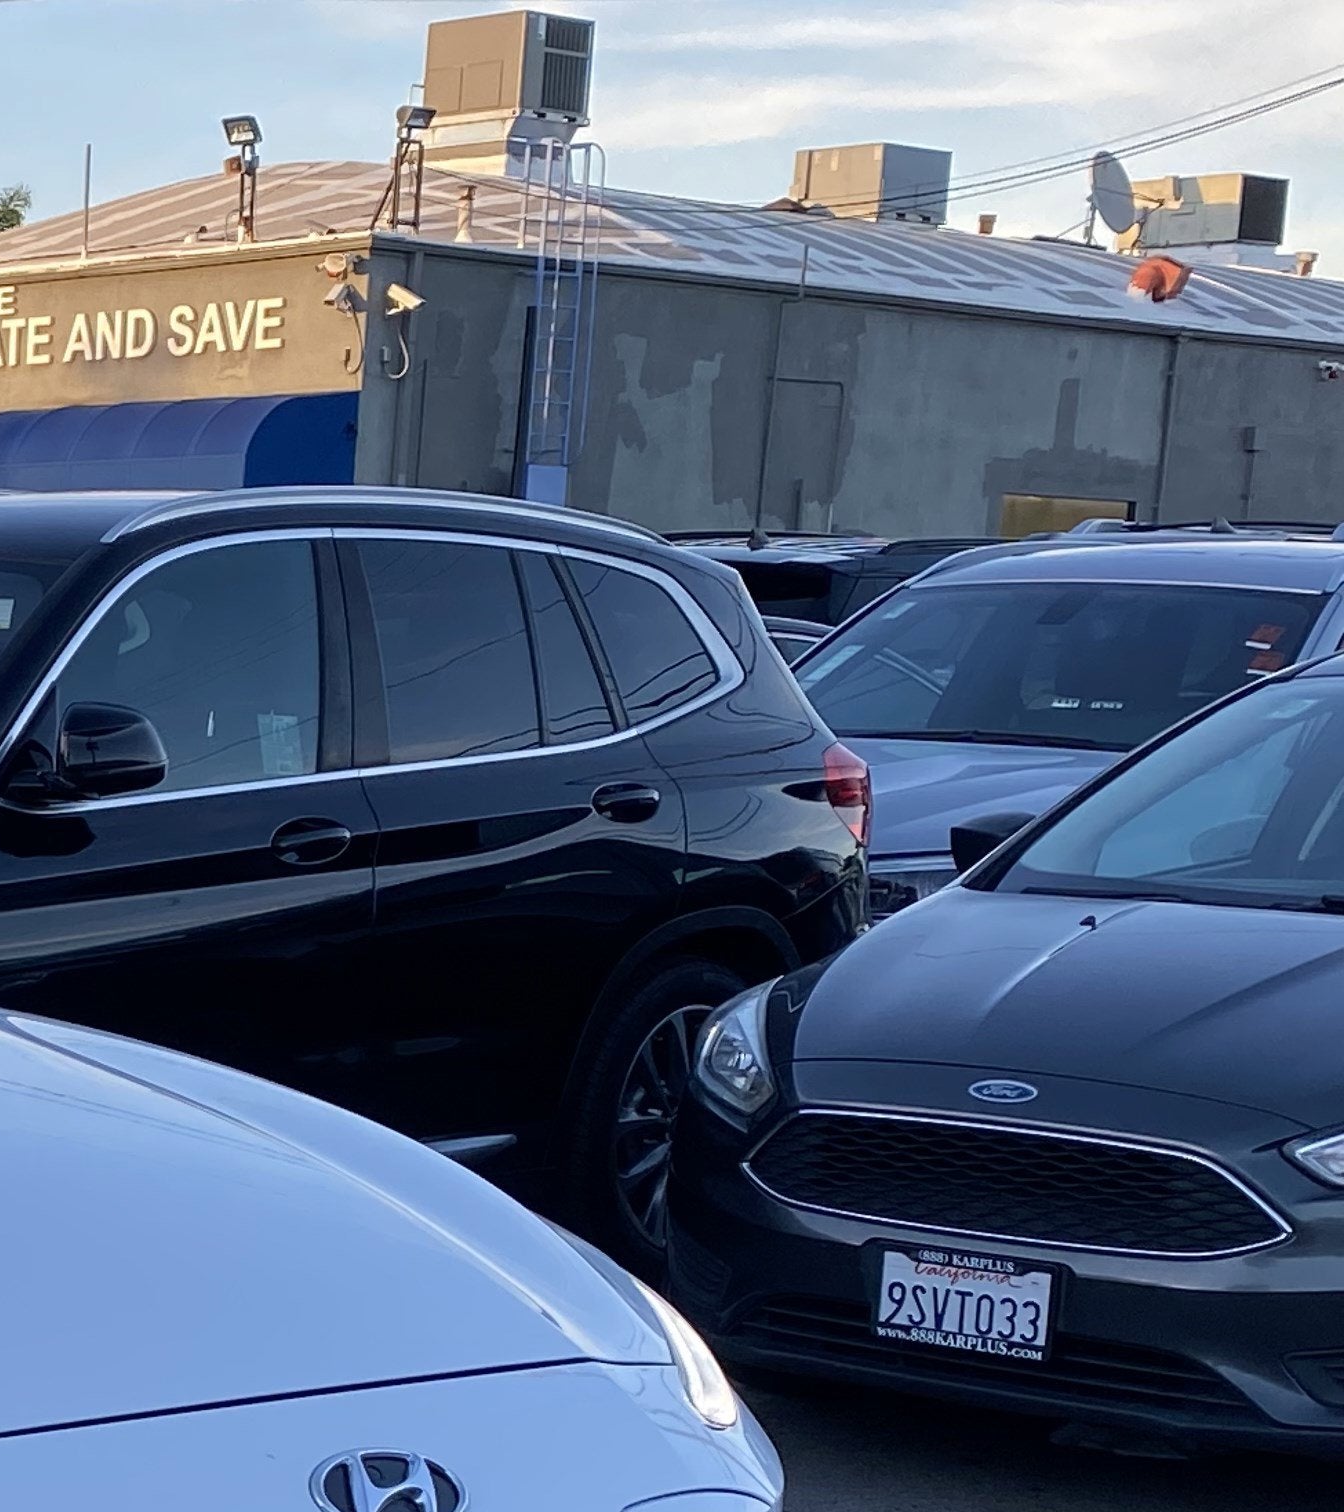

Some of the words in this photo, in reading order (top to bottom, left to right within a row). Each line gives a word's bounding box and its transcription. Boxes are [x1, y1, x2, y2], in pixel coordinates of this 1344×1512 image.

[62, 308, 156, 363] AND
[167, 297, 286, 357] SAVE
[918, 1250, 949, 1266] (888)
[952, 1253, 1015, 1273] KARPLUS
[884, 1281, 1042, 1343] 9SVT033
